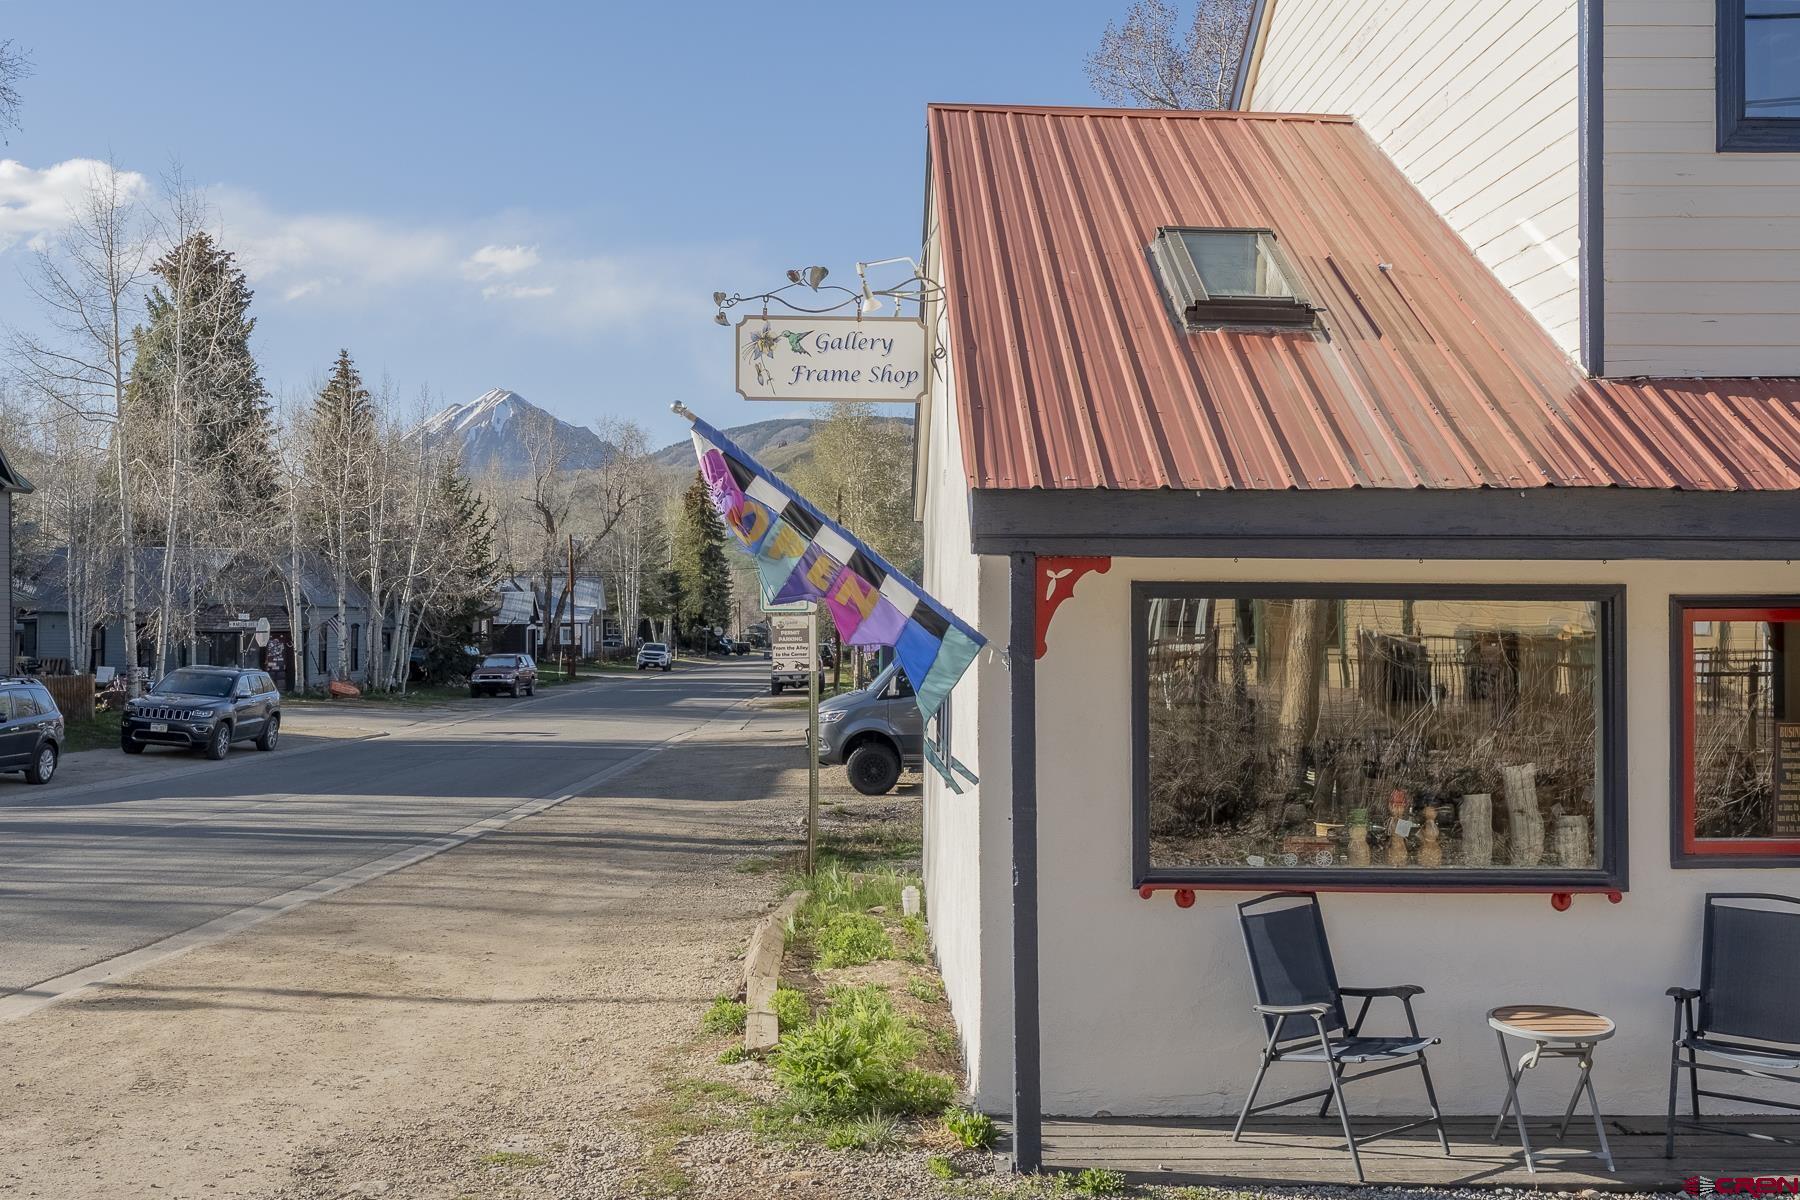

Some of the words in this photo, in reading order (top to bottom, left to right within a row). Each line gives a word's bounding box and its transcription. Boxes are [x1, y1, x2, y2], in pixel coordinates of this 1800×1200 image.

[815, 331, 894, 357] Gallery
[788, 365, 861, 385] Frame
[868, 363, 919, 389] Shop
